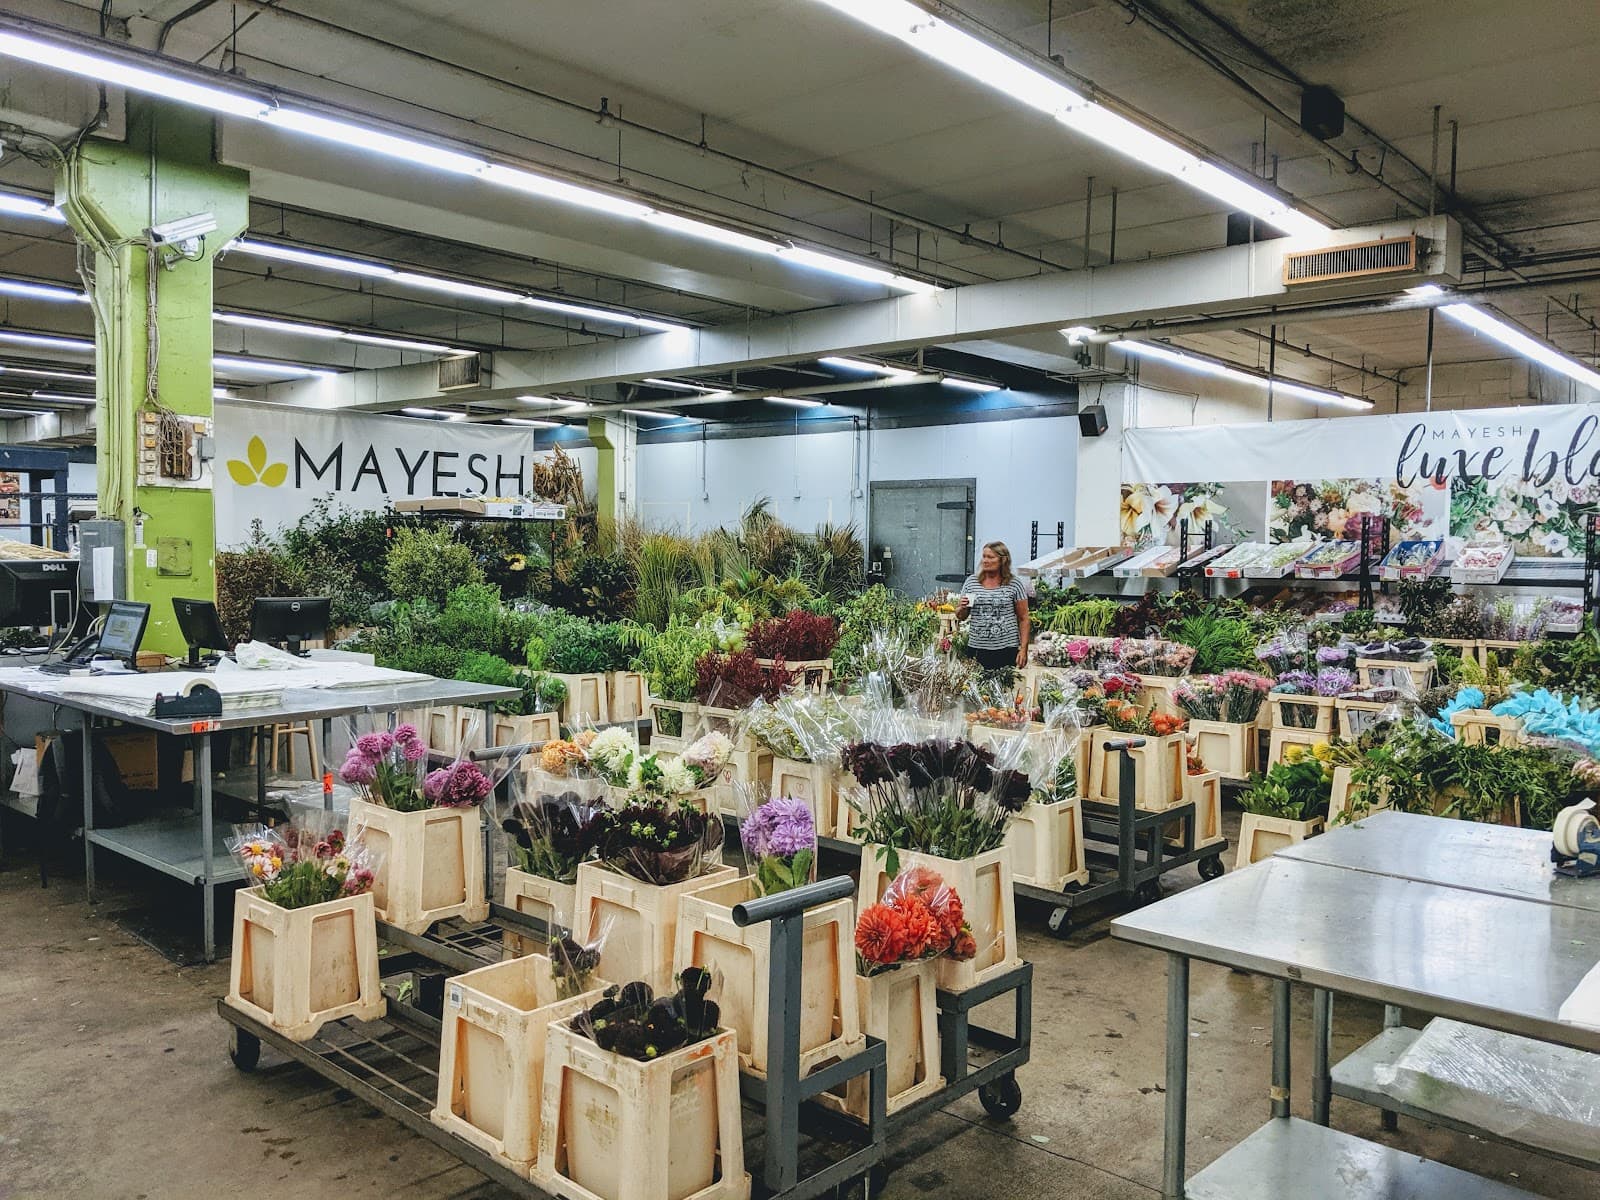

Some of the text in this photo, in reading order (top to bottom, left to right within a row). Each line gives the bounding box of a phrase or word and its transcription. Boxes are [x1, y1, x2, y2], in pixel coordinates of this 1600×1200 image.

[1432, 425, 1523, 441] MAYESH
[294, 437, 525, 498] MAYESH
[1396, 423, 1513, 489] luxe
[42, 563, 68, 571] DELL
